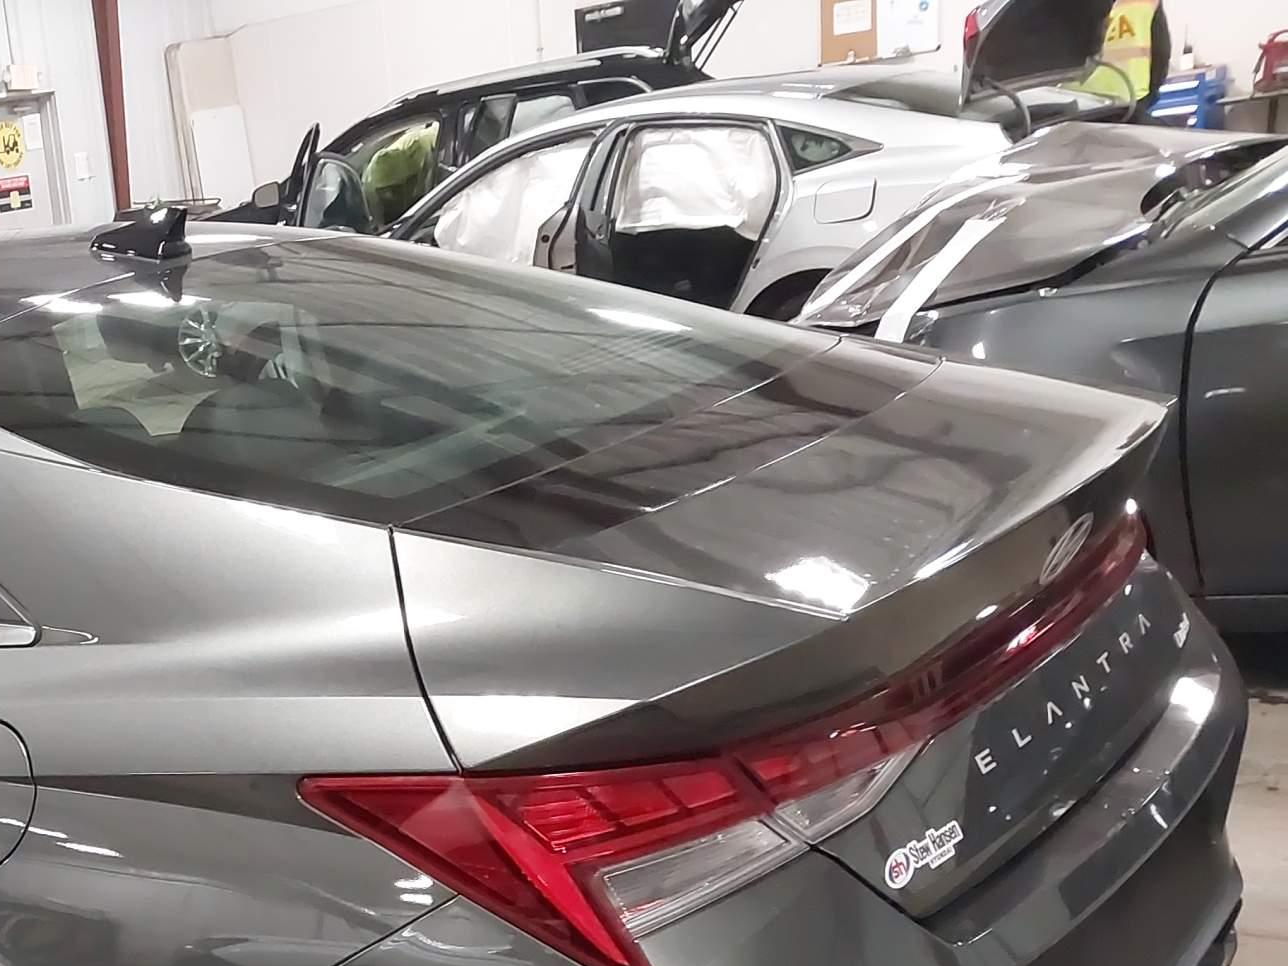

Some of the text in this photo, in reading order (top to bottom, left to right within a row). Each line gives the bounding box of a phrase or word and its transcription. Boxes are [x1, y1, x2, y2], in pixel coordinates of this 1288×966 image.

[974, 613, 1151, 776] ELANTRA
[908, 824, 961, 865] Stew Hansen
